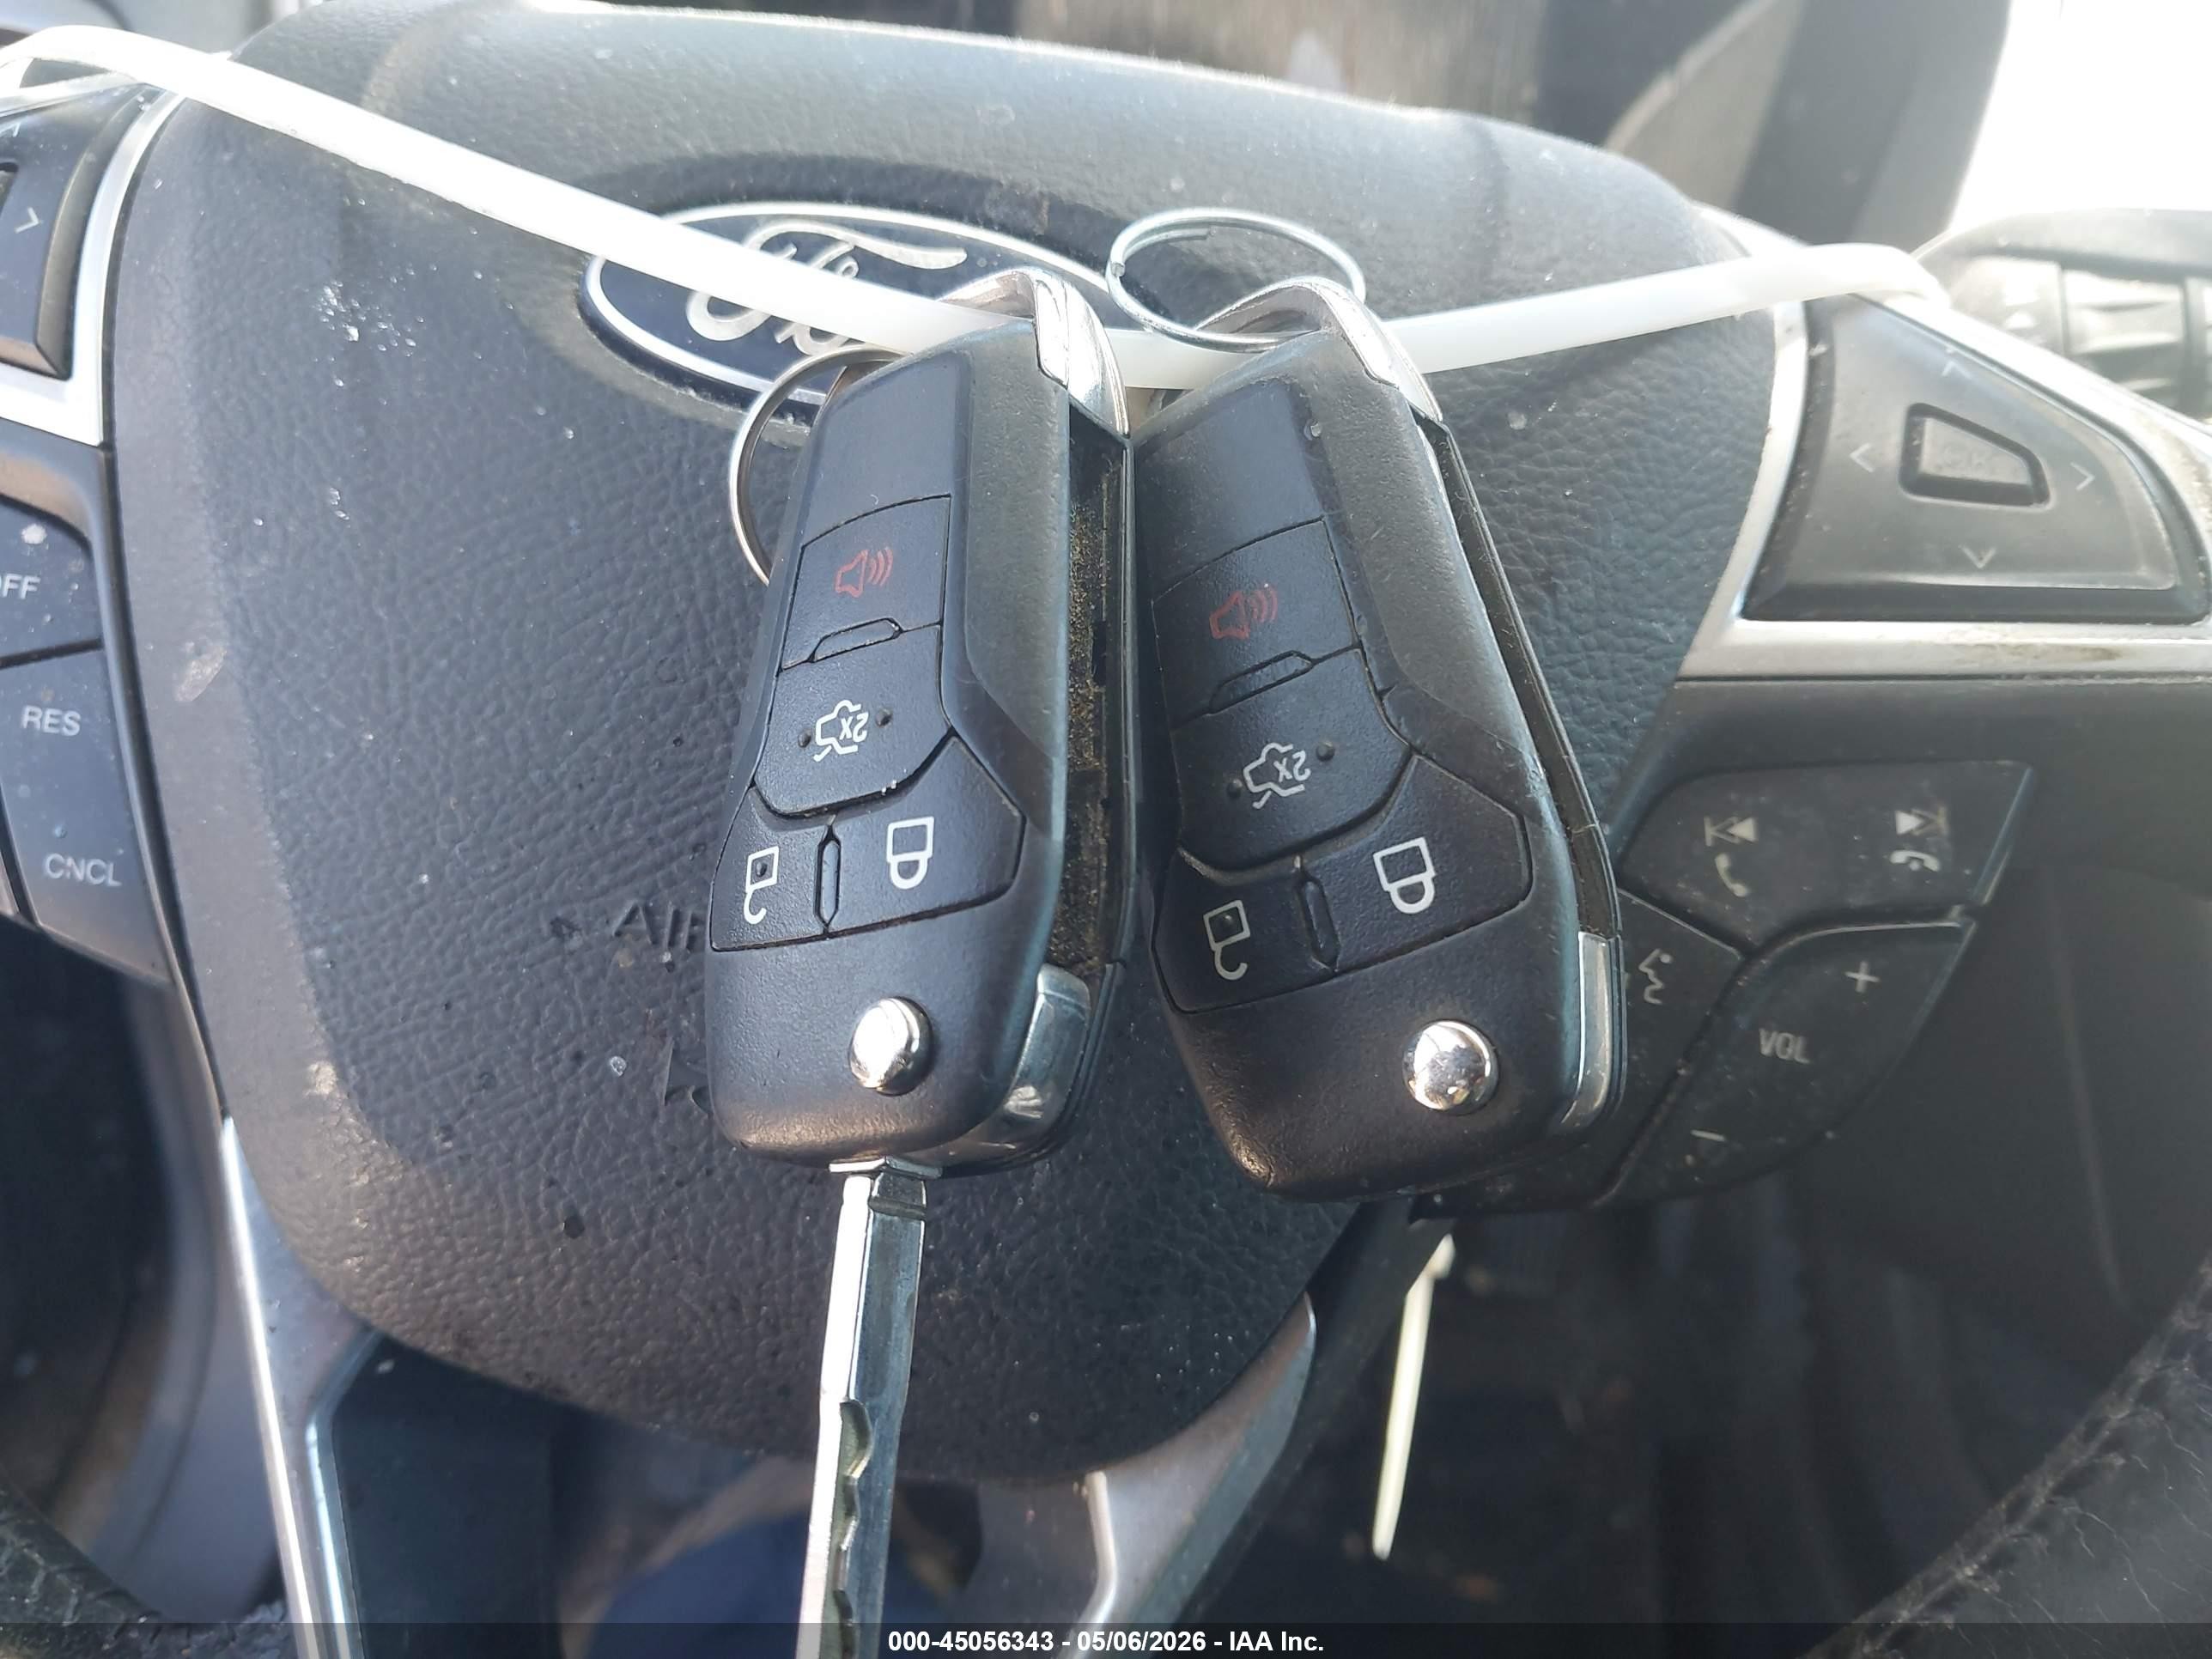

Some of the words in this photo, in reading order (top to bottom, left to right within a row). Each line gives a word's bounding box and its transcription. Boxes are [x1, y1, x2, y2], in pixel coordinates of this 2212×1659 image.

[0, 573, 41, 599] FF
[21, 706, 82, 737] RES
[43, 853, 122, 888] CNCL
[1758, 1028, 1811, 1064] VOL
